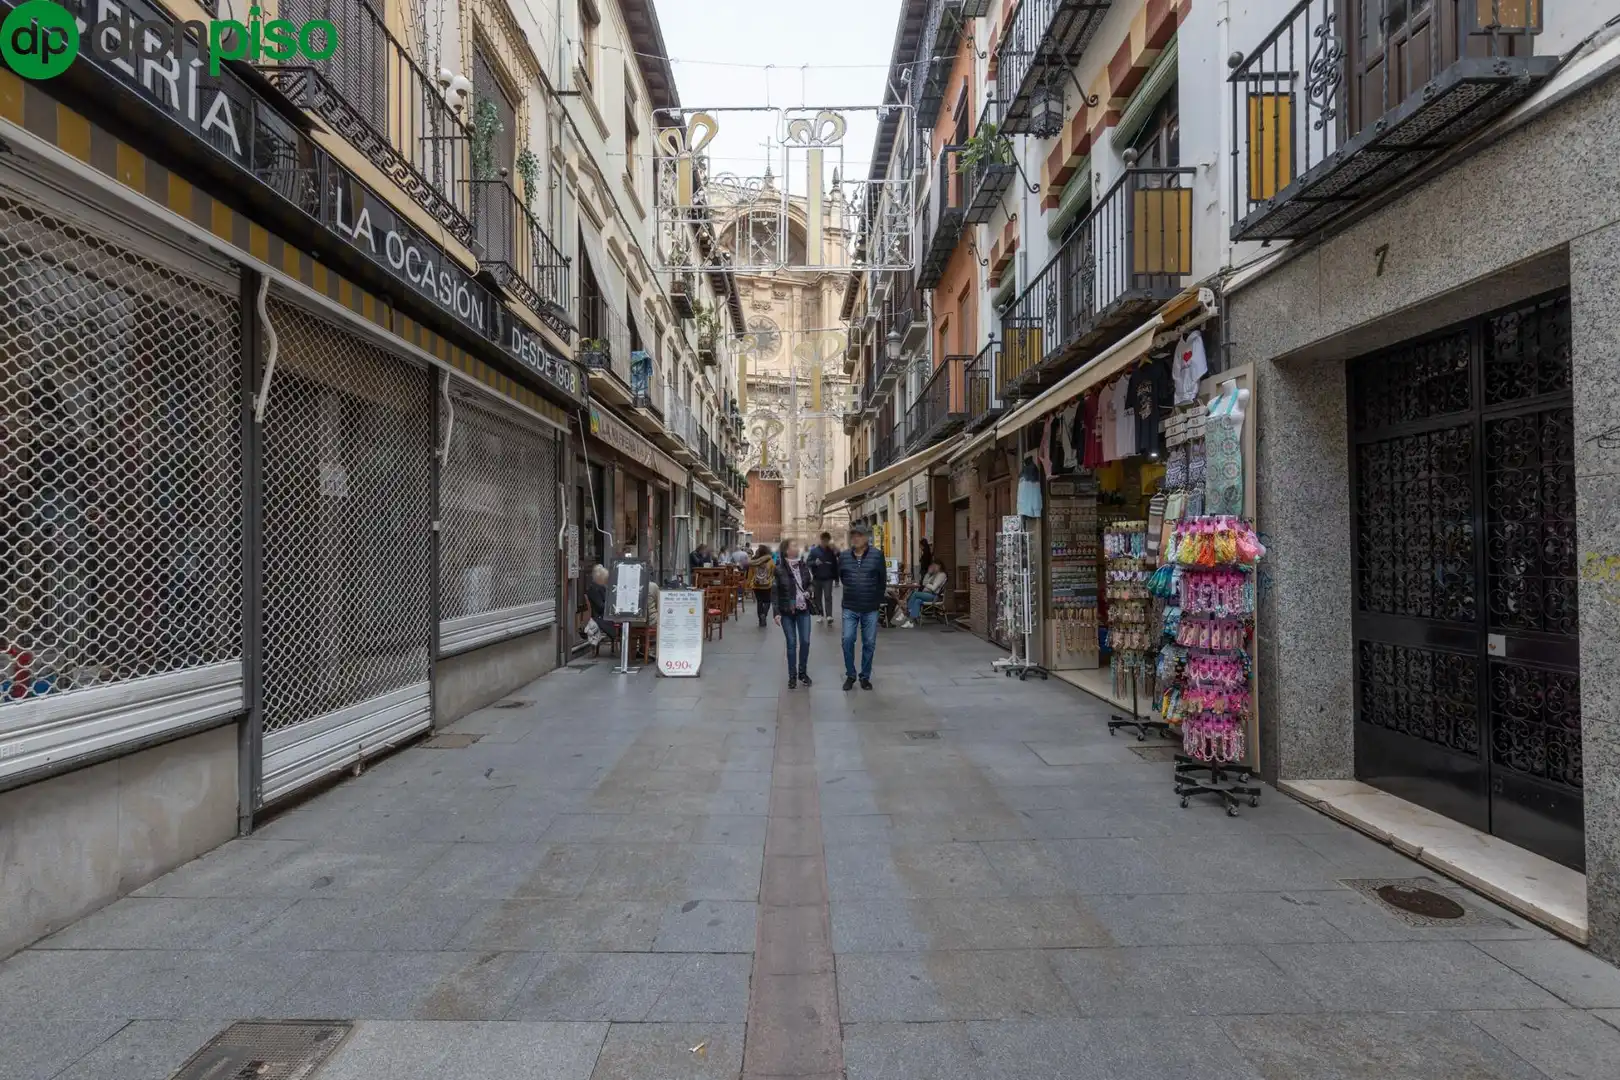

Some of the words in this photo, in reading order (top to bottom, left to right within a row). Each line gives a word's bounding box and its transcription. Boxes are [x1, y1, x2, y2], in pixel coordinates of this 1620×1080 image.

[75, 0, 242, 156] ERÍA
[336, 187, 377, 253] LA
[385, 230, 485, 330] OCASIÓN
[1375, 243, 1389, 277] 7
[511, 326, 551, 378] DESDE
[555, 359, 576, 393] 1908
